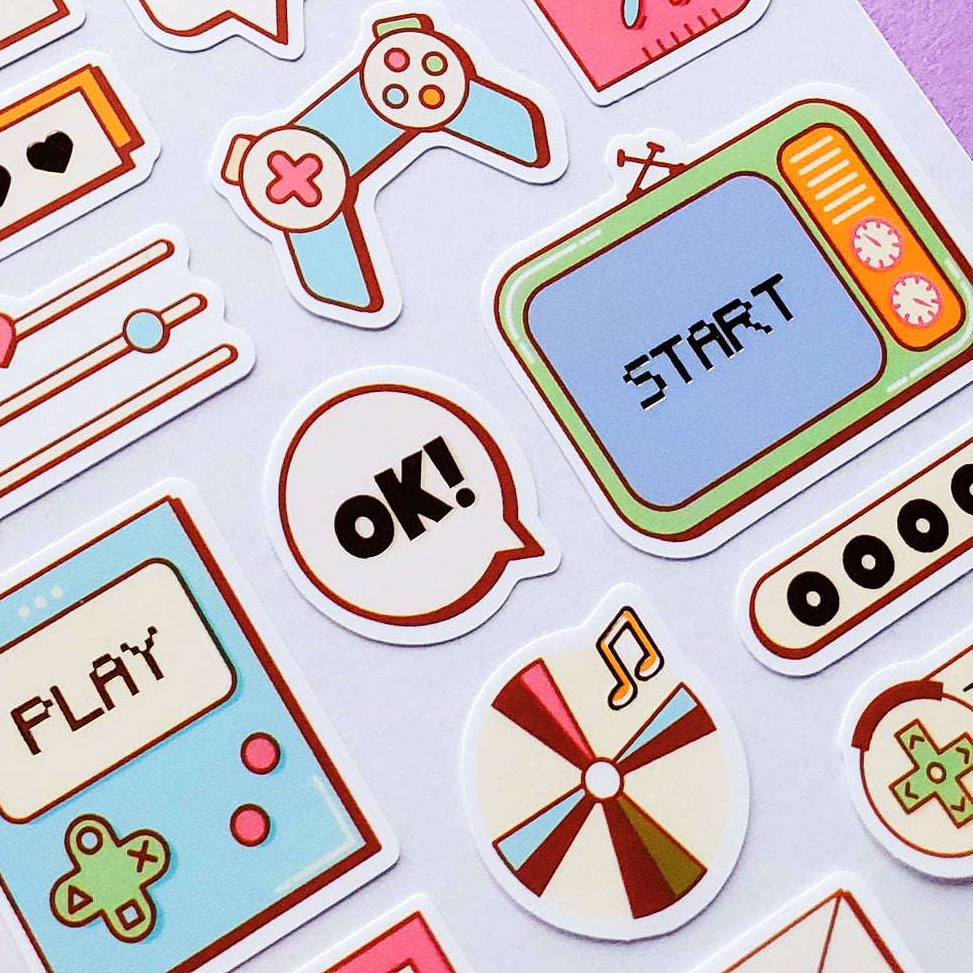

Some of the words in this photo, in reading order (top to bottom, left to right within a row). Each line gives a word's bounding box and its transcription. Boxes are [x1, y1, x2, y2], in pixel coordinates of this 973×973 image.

[622, 273, 794, 410] START
[334, 435, 476, 559] OK!
[10, 626, 165, 756] PLAY
